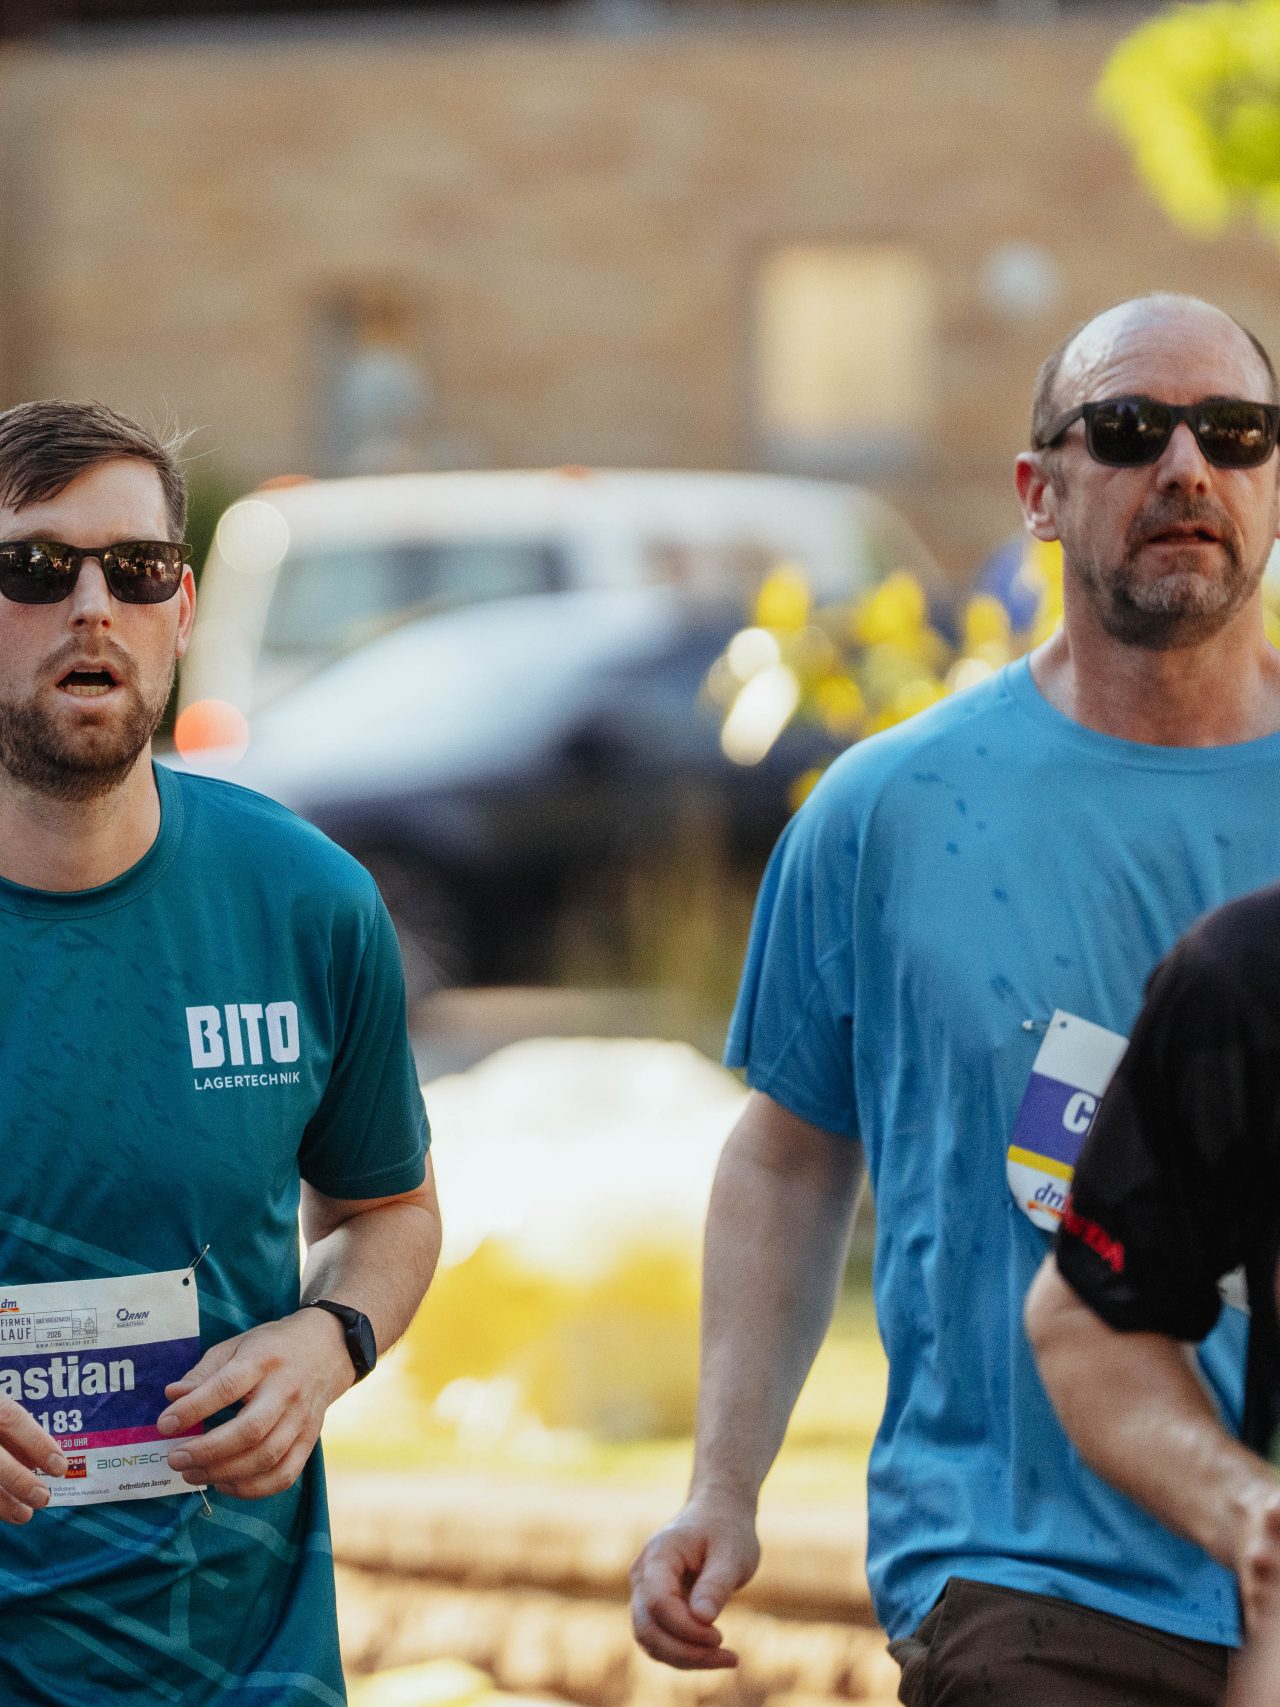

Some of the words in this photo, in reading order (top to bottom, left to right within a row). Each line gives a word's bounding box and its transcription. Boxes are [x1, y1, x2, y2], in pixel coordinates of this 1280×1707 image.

[185, 1001, 300, 1069] BITO
[194, 1072, 300, 1091] LAGERTECHNIK
[0, 1299, 17, 1309] dm
[0, 1316, 32, 1327] FIRMEN
[0, 1327, 32, 1341] LAUF
[28, 1409, 83, 1434] 183
[74, 1437, 88, 1447] UHR
